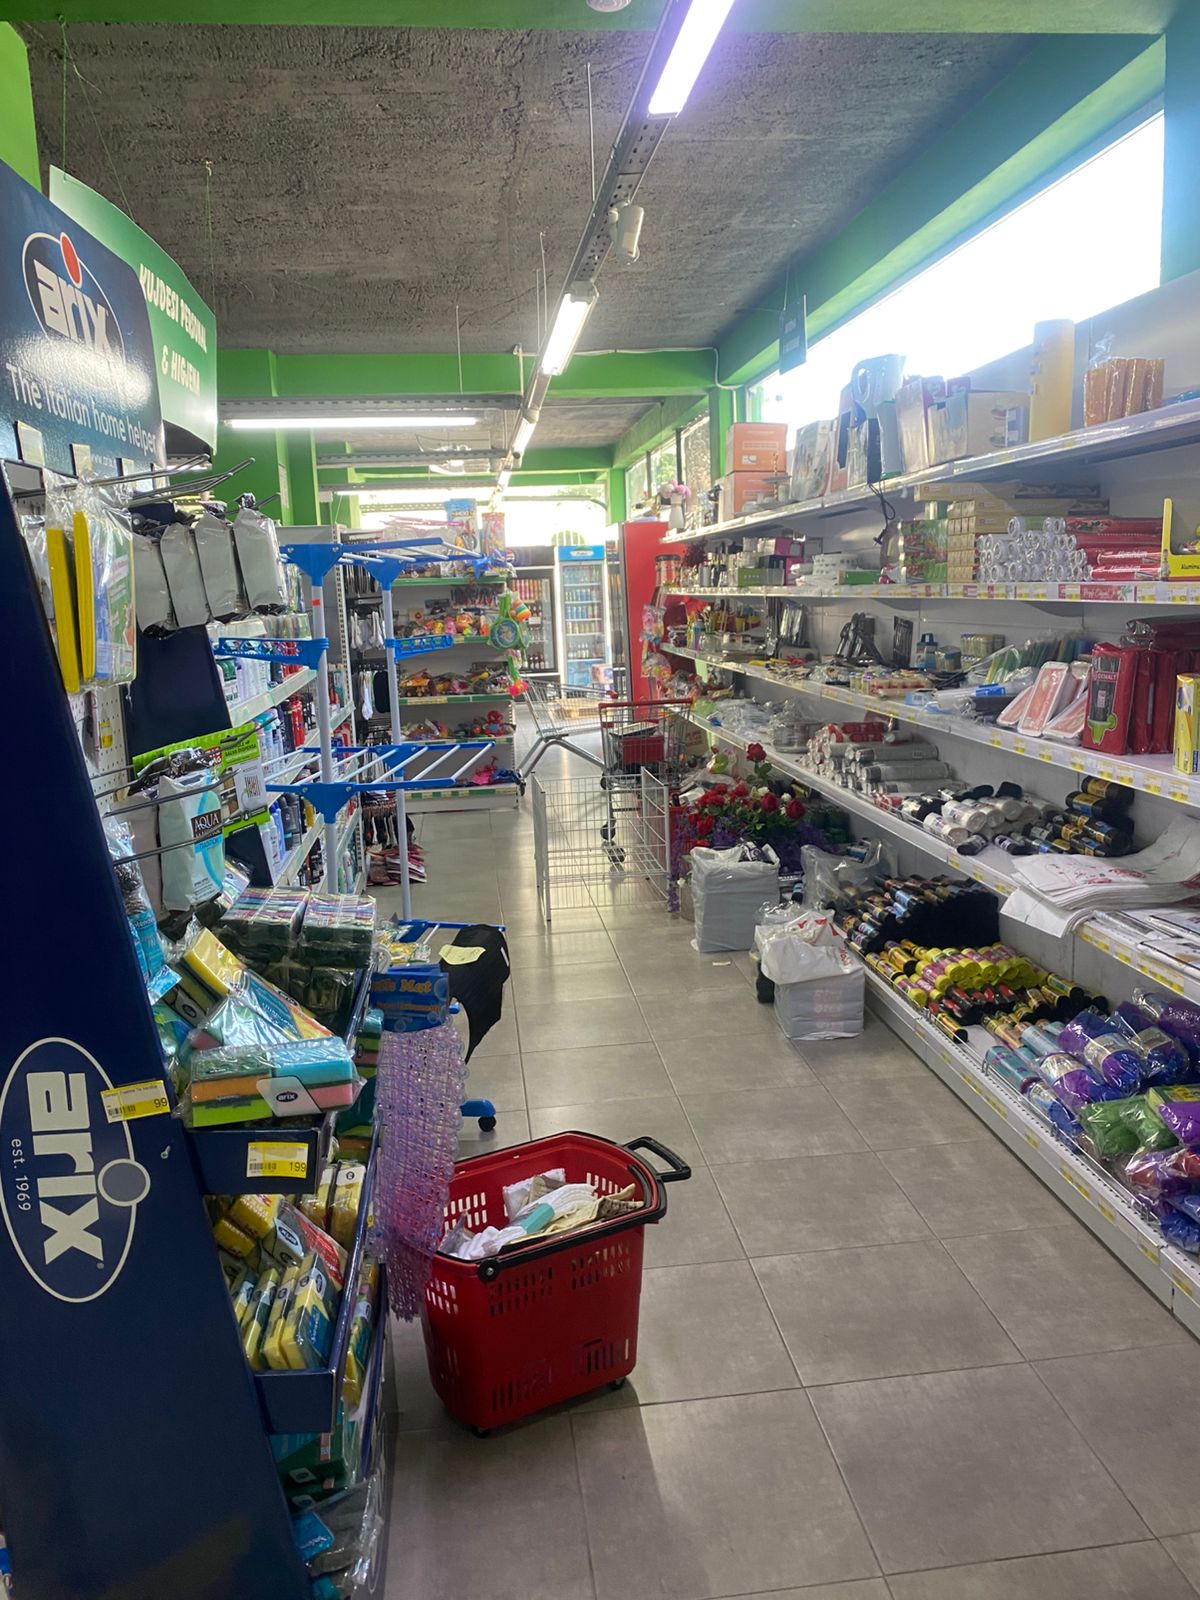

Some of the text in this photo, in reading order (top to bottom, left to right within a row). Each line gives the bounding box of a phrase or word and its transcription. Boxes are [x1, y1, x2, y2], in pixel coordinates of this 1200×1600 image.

[161, 345, 169, 375] &
[6, 361, 156, 456] The Italian home helper
[194, 812, 220, 829] AQUA
[154, 1097, 168, 1108] 99
[278, 1092, 298, 1103] arix
[11, 1138, 31, 1211] est. 1969
[27, 1072, 104, 1265] arix
[289, 1161, 306, 1172] 199
